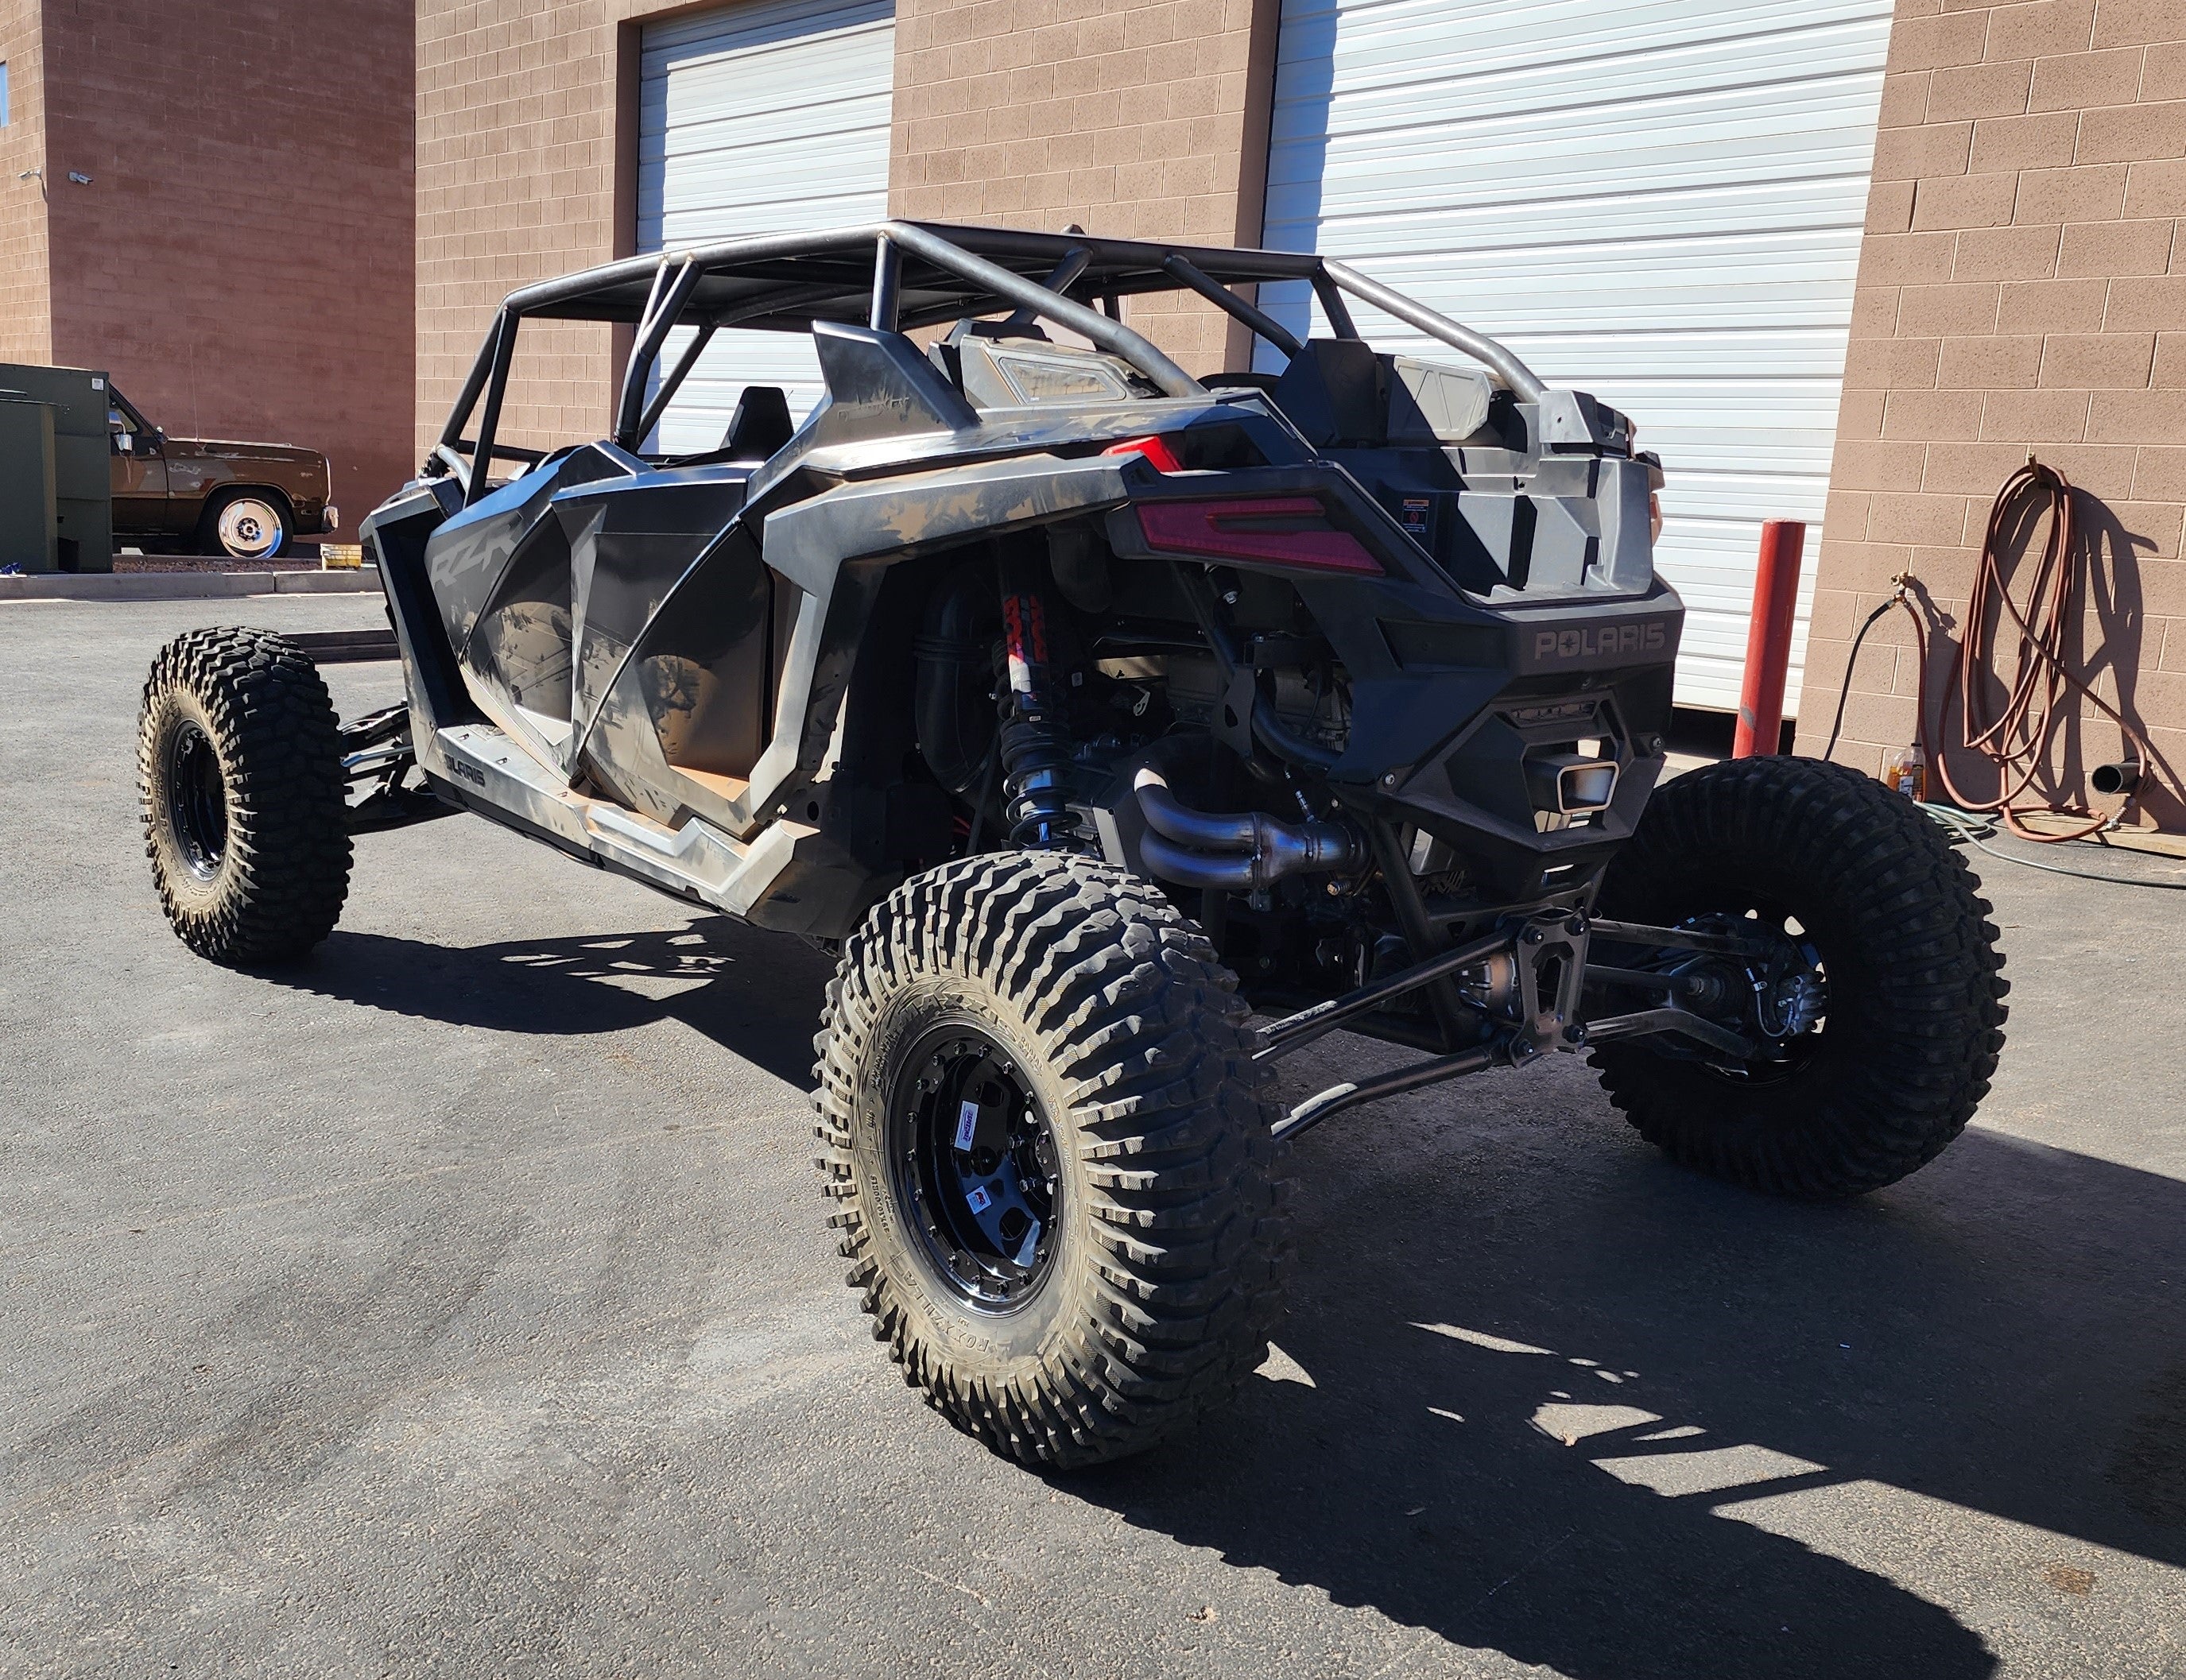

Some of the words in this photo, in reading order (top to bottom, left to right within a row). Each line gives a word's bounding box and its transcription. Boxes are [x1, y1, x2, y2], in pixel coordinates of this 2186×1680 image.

[1534, 622, 1665, 660] POLARIS
[899, 993, 1017, 1043] MAXXIS
[903, 1271, 990, 1353] ROXXZILLA
